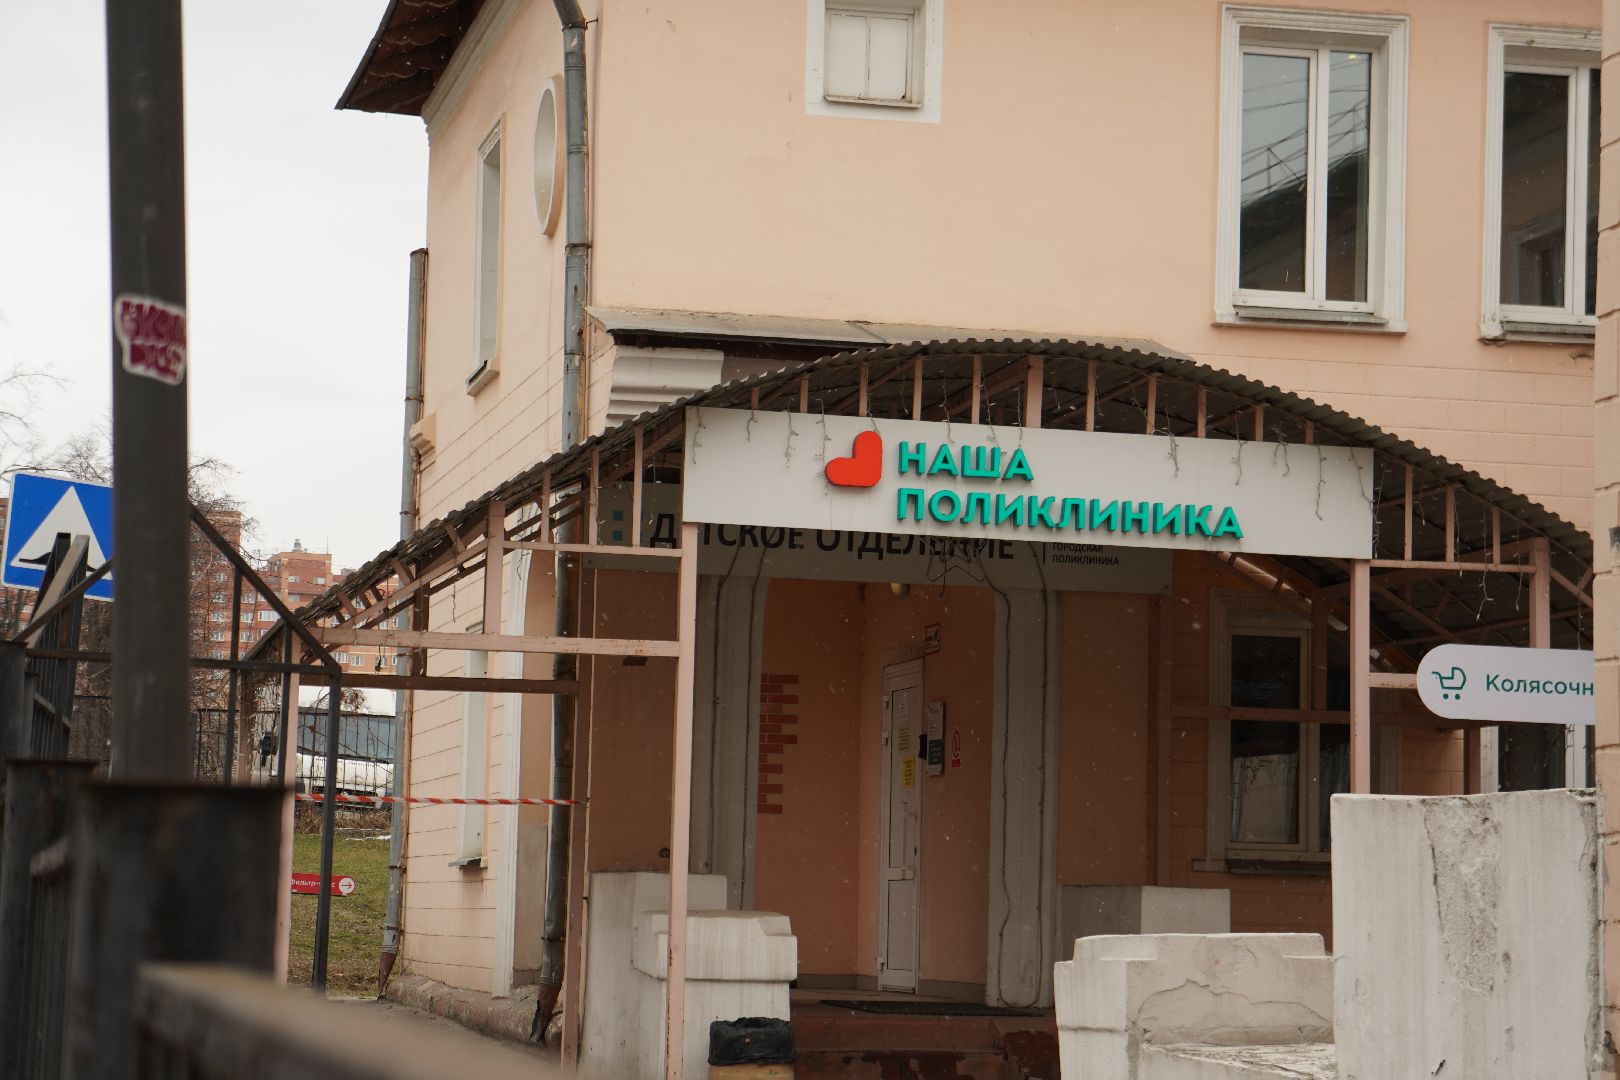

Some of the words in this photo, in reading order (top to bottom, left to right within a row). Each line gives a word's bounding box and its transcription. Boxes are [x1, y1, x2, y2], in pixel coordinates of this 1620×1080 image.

[899, 441, 1034, 482] НАША
[650, 513, 804, 549] ДТСКОЕ
[897, 488, 1245, 540] ПОЛИКЛИНИКА
[1052, 554, 1119, 565] ПОЛИКЛИНИКА
